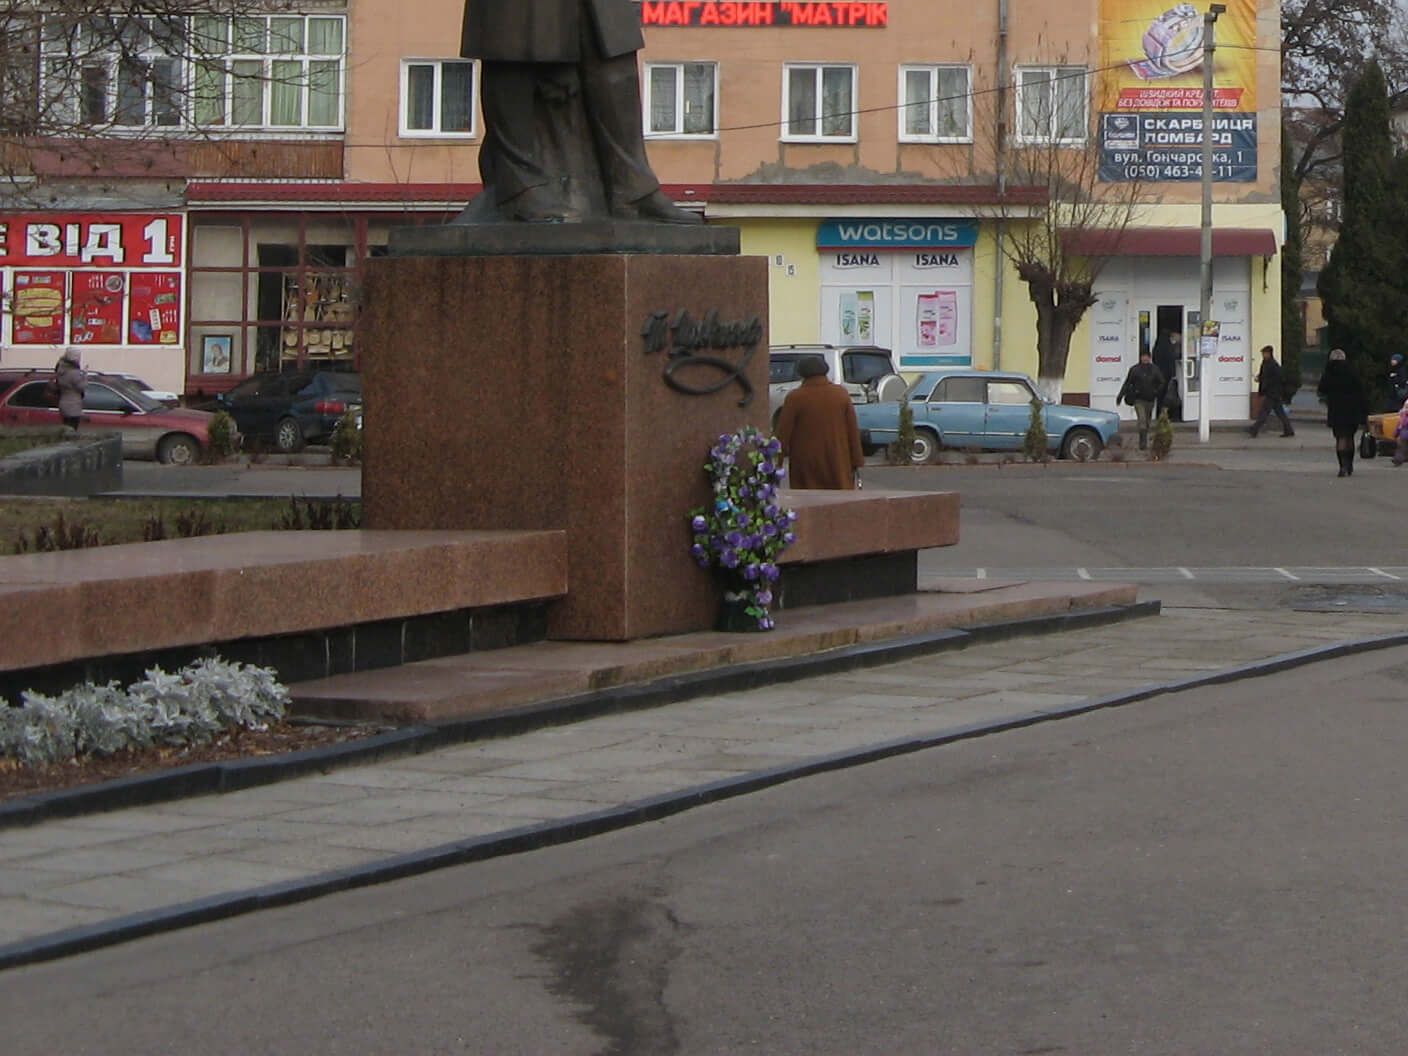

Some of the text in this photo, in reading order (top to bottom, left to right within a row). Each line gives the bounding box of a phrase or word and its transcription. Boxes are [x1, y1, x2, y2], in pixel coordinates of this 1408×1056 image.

[642, 1, 773, 26] МАГАЗИН
[1144, 119, 1253, 131] СКАРБИЦЯ
[1114, 151, 1243, 165] вул. Гончарока, 1
[1124, 165, 1232, 178] (050) 463-4-11
[838, 223, 959, 241] watsons
[26, 223, 125, 263] ВІД
[142, 218, 174, 263] 1
[836, 253, 880, 266] ISANA
[916, 253, 960, 266] ISANA
